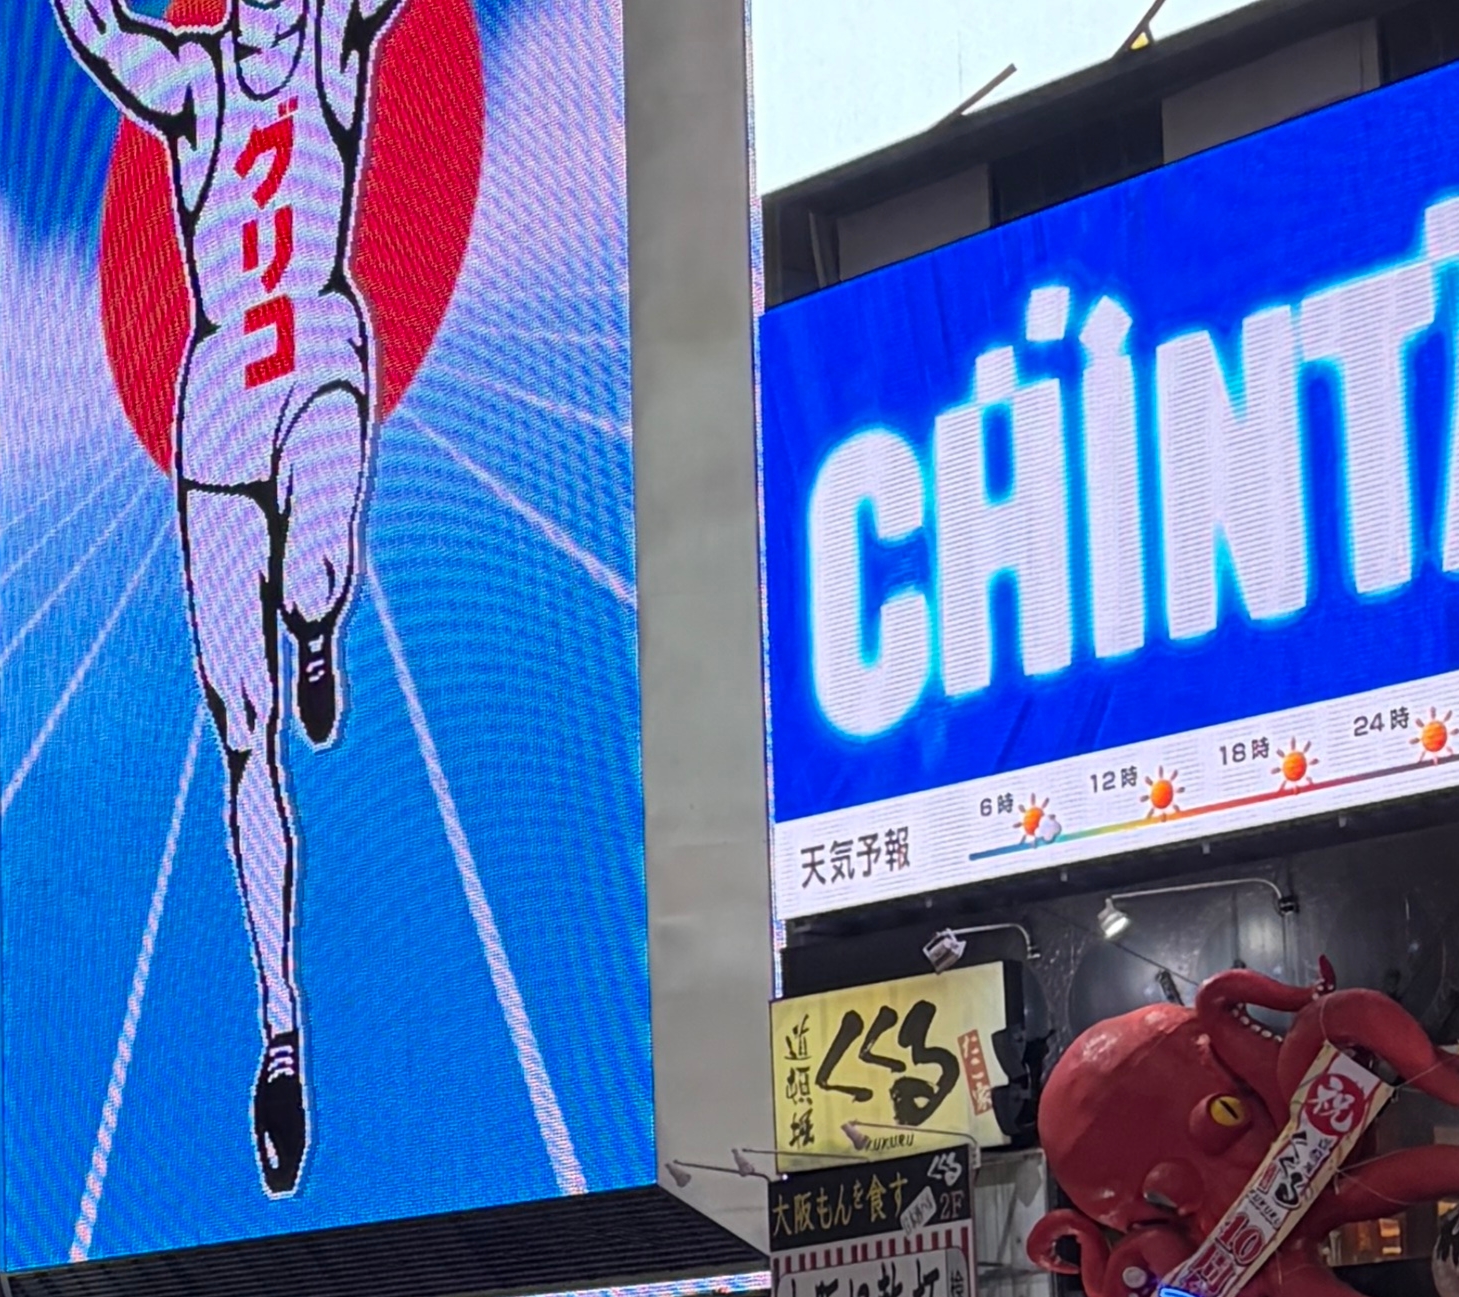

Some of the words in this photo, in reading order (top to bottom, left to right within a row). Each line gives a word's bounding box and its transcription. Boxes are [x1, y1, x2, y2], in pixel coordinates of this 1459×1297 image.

[234, 97, 298, 389] グリコ
[1353, 707, 1411, 737] 24時
[1089, 766, 1139, 793] 12時
[1218, 738, 1271, 765] 18時
[980, 792, 1015, 817] 6時
[801, 826, 911, 889] 天気予報
[784, 1014, 815, 1148] 道頓堀
[816, 1000, 960, 1126] くくる
[1314, 1075, 1356, 1132] 祝
[927, 1152, 962, 1186] くくる
[1274, 1130, 1308, 1209] くくる
[772, 1171, 908, 1236] 大阪もんを食す
[940, 1190, 963, 1220] 2F
